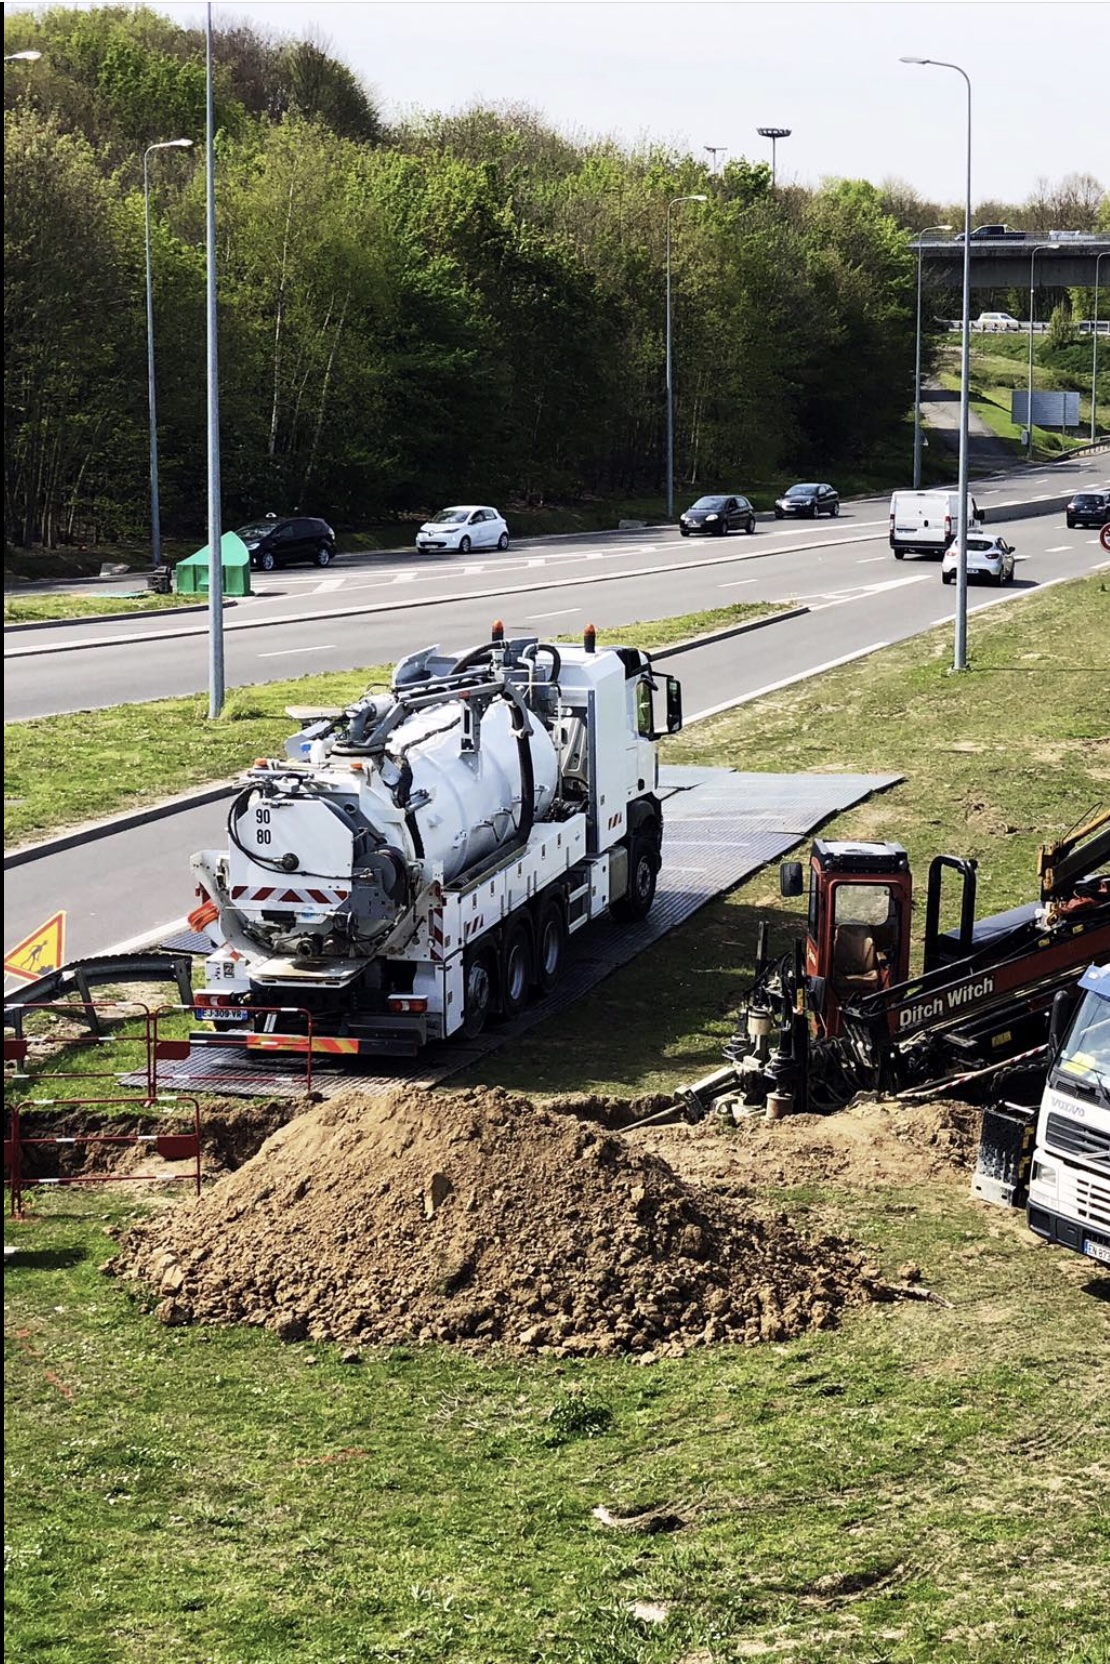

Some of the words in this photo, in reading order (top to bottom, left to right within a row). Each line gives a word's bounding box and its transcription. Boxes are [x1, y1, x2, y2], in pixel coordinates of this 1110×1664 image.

[255, 809, 271, 824] 90
[256, 829, 271, 845] 80
[900, 998, 943, 1027] Ditch
[947, 977, 994, 1008] Witch
[1050, 1096, 1085, 1117] VOLVO
